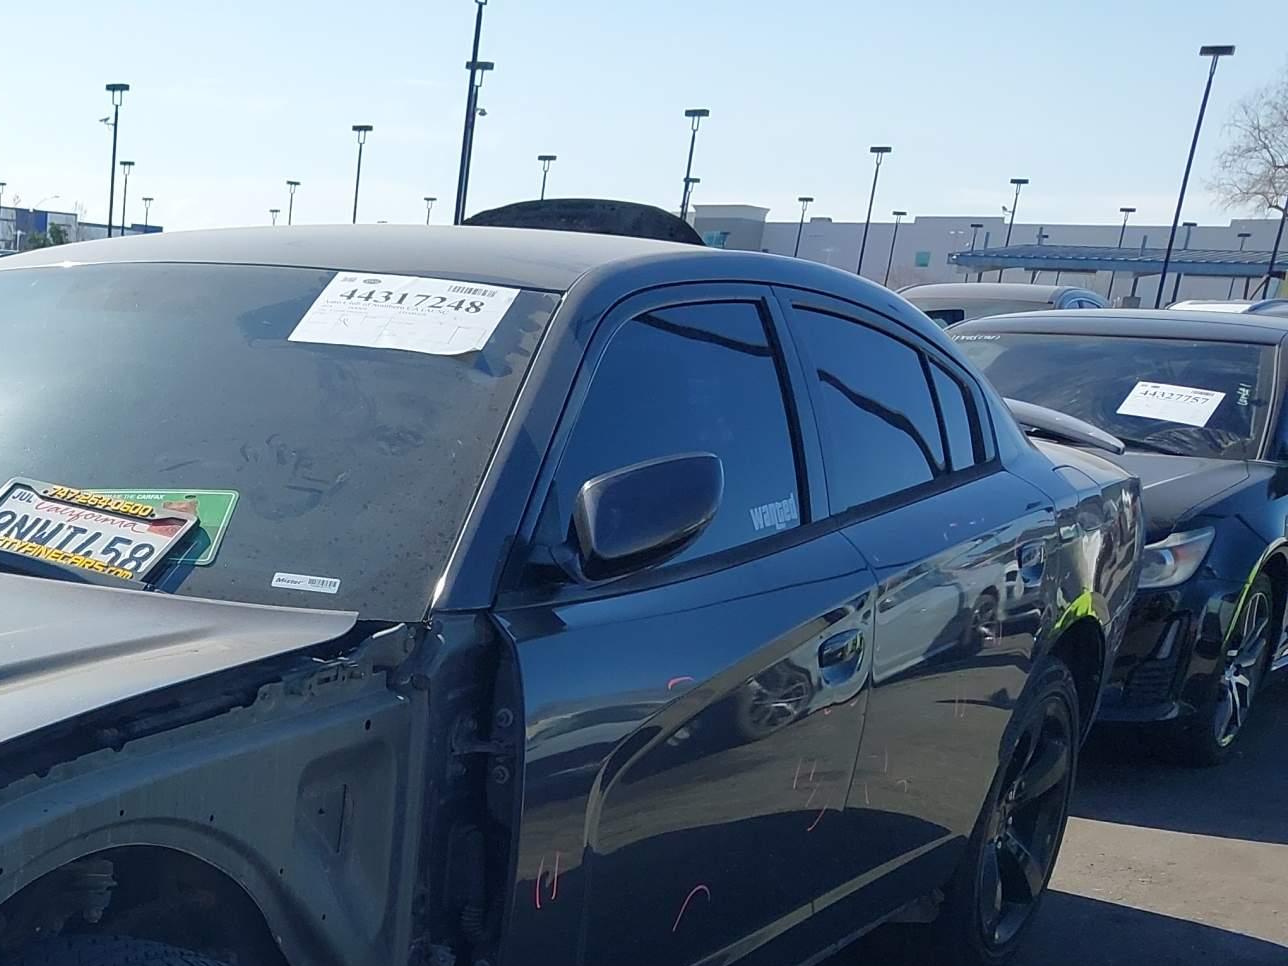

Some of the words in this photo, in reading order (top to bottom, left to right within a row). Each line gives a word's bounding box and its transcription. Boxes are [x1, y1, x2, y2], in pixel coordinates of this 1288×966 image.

[339, 288, 485, 314] 44317248
[1139, 389, 1210, 405] 44327757
[12, 490, 33, 504] JUL
[35, 500, 146, 534] California
